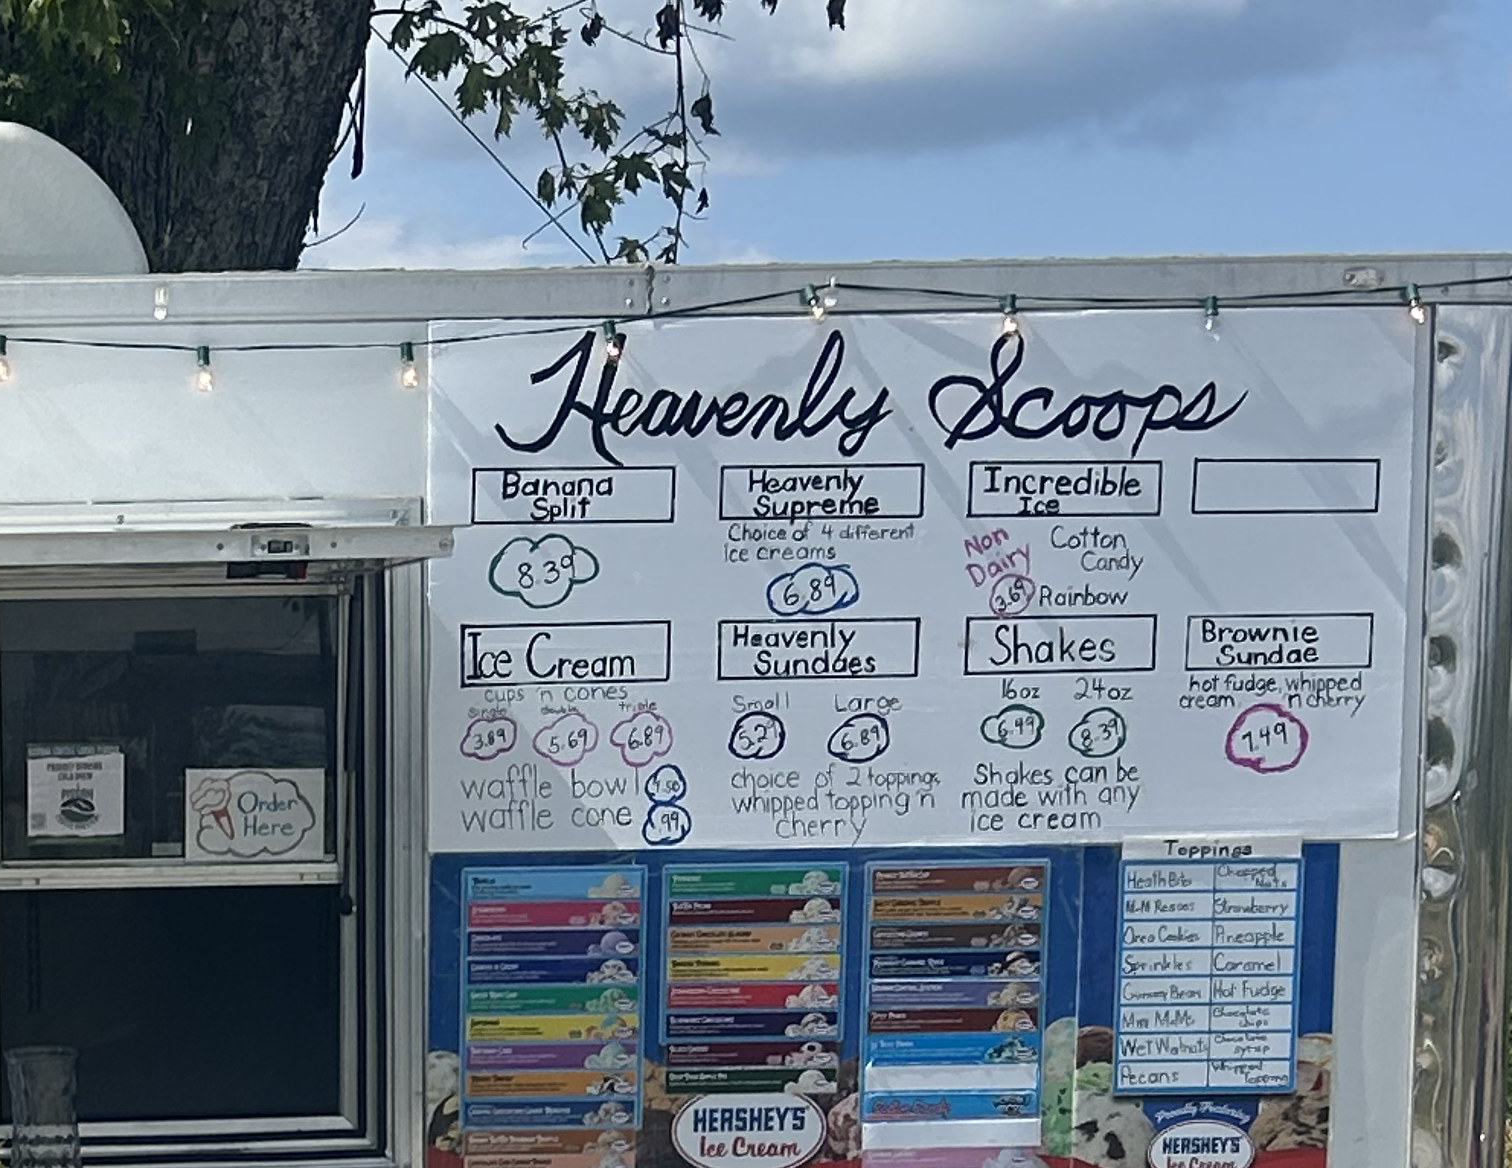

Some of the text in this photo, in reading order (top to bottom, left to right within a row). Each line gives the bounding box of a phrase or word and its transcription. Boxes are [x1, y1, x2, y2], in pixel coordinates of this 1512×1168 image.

[495, 332, 1249, 466] Heavenly Scoops
[502, 470, 614, 500] Banana
[748, 469, 864, 501] Heavenly
[984, 466, 1142, 496] Incredible
[530, 498, 590, 522] Split
[753, 495, 880, 524] Supreme
[1017, 497, 1060, 515] Ice
[728, 520, 915, 541] Choice of 4 different
[965, 528, 1009, 557] Non
[1051, 526, 1127, 549] Cotton
[724, 544, 836, 563] ice creams
[965, 543, 1030, 587] Dairy
[1081, 549, 1144, 581] Candy
[783, 575, 836, 605] 6.89
[1039, 584, 1128, 607] Rainbow
[732, 622, 855, 655] Heavenly
[1202, 619, 1319, 643] Brownie
[466, 632, 635, 680] Ice Cream
[989, 624, 1115, 666] Shakes
[1216, 644, 1319, 666] Sundae
[754, 650, 876, 676] Sundaes
[484, 686, 628, 707] cups cones
[1189, 673, 1220, 692] hot
[1285, 671, 1363, 697] whipped
[619, 700, 657, 712] triple
[732, 692, 902, 715] Small Large
[1306, 690, 1366, 717] cherry
[549, 729, 587, 753] 5.69
[628, 726, 664, 750] 6.89
[841, 725, 880, 751] 6.89
[1081, 718, 1118, 748] 8.39
[460, 764, 639, 800] waffle bowl
[731, 762, 861, 790] choice of 2
[973, 756, 1140, 786] Shakes can be
[237, 792, 298, 815] Order
[732, 788, 910, 820] whipped topping
[962, 784, 1140, 813] made with any
[242, 816, 295, 836] Here
[461, 800, 632, 833] waffle cone
[970, 810, 1101, 832] ice cream
[776, 812, 866, 847] cherry
[1163, 840, 1252, 859] Toppings
[1127, 871, 1166, 889] Heath
[1215, 897, 1289, 916] Strawberry
[1124, 925, 1200, 944] Oreo Cookies
[1215, 922, 1285, 946] Pineapple
[1122, 953, 1192, 975] Sprinkles
[1214, 951, 1281, 972] Caramel
[1213, 980, 1286, 1000] Hot Fudge
[1120, 1039, 1153, 1057] Wet
[1120, 1065, 1179, 1085] Pecans
[693, 1107, 806, 1133] HERSHEY'S
[700, 1136, 801, 1158] Ice Cream
[1162, 1136, 1241, 1155] HERSHEY'S
